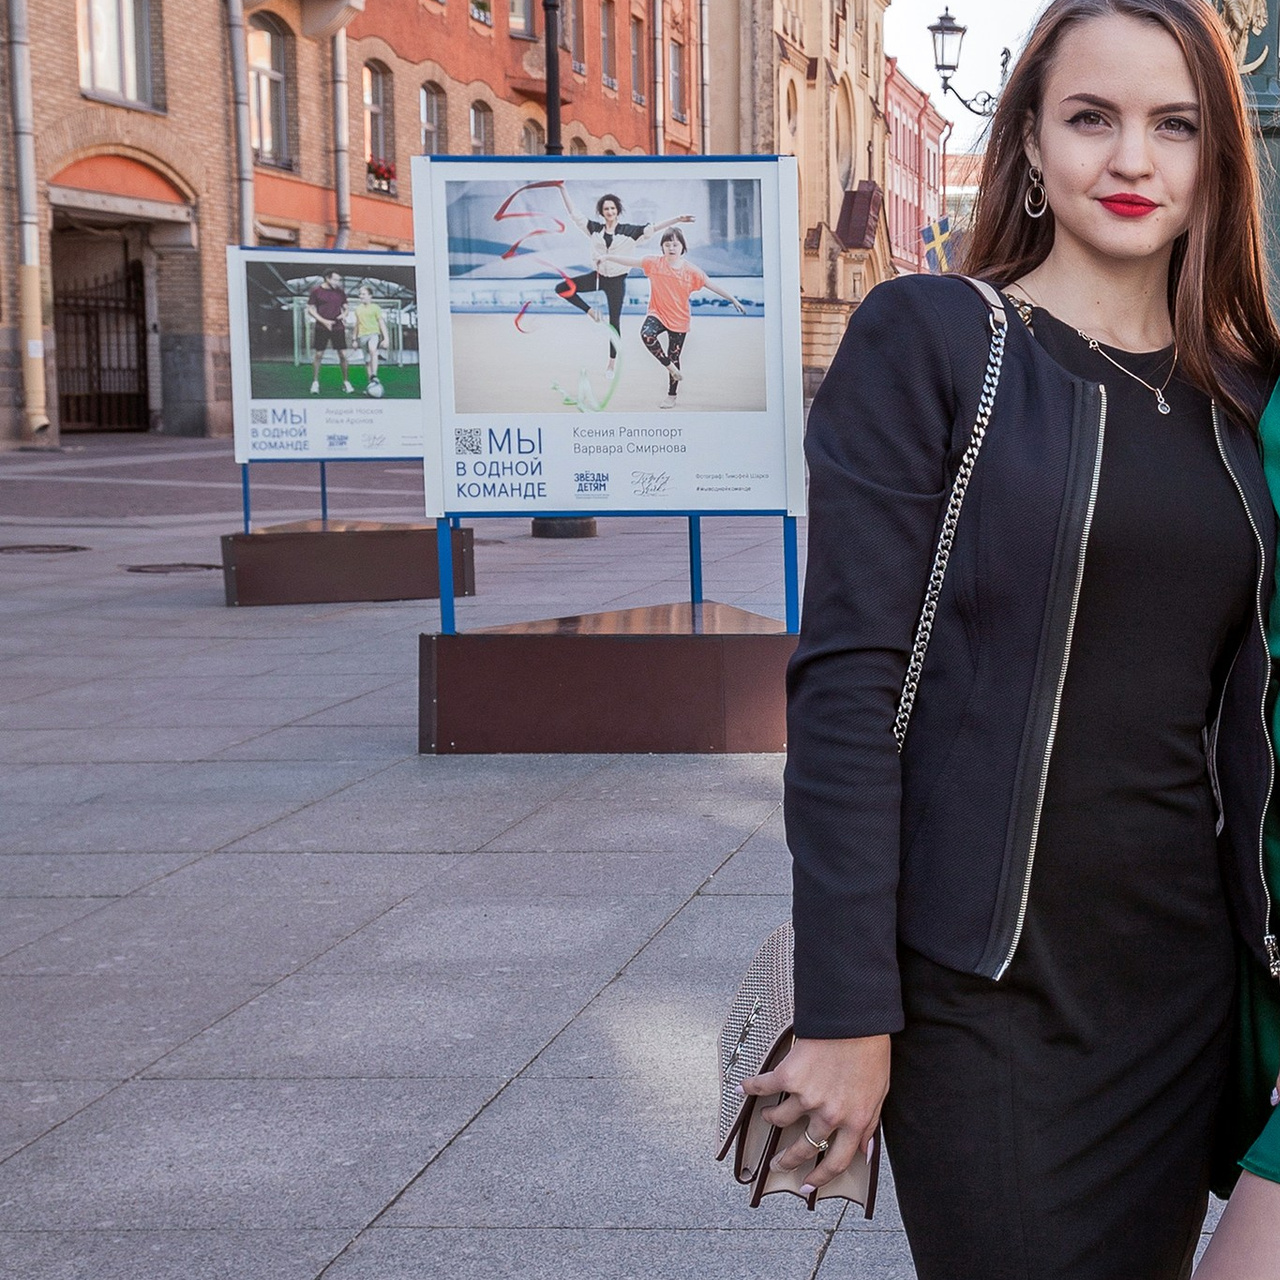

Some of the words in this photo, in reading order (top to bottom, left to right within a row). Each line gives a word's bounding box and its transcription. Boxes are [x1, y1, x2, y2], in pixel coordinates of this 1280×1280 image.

[271, 409, 307, 424] МЫ
[251, 428, 258, 437] В
[262, 426, 307, 438] ОДНОЙ
[572, 426, 616, 438] Ксения
[619, 427, 683, 438] Раппопорт
[251, 440, 309, 451] КОМАНДЕ
[488, 427, 543, 455] МЫ
[573, 442, 623, 454] Варвара
[626, 442, 687, 454] Смирнова
[455, 461, 466, 476] В
[473, 457, 543, 478] ОДНОЙ
[573, 471, 609, 483] ЗВЁЗДЫ
[456, 482, 547, 500] КОМАНДЕ
[576, 482, 607, 493] ДЕТЯМ
